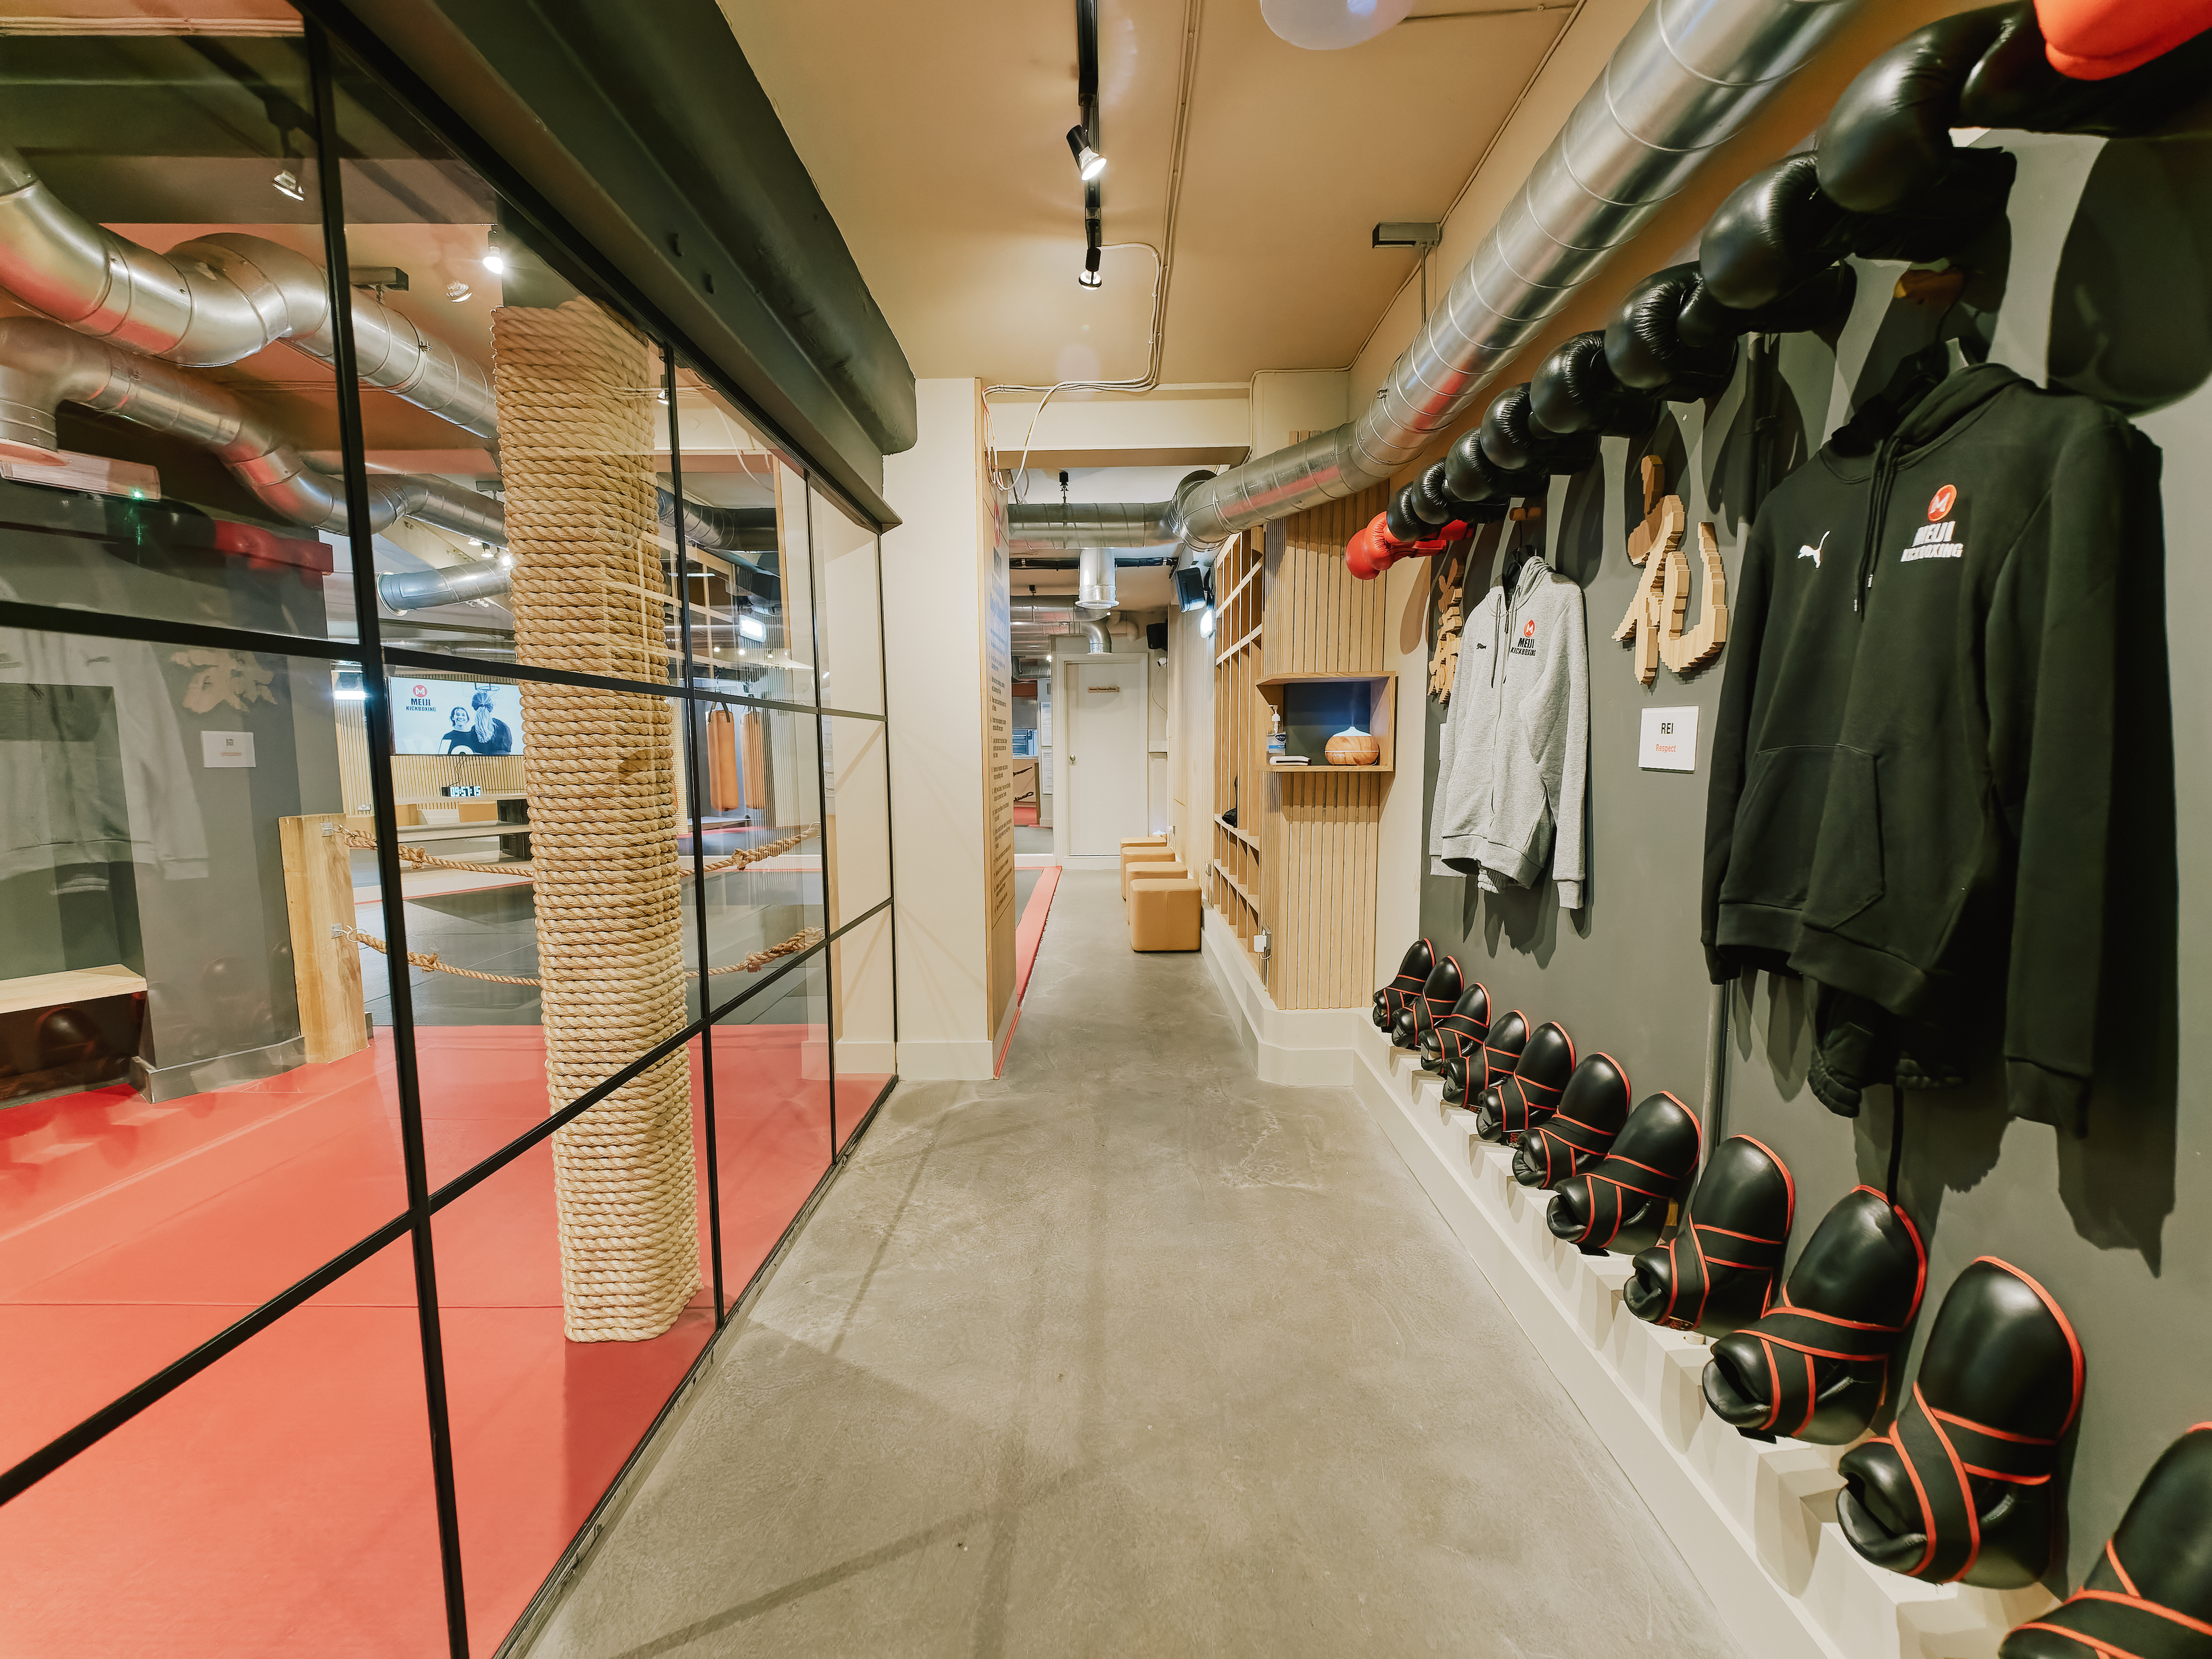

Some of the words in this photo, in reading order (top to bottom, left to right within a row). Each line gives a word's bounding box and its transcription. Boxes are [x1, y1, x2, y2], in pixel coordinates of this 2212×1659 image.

[1518, 637, 1534, 648] MEIJI
[1661, 723, 1674, 734] REI
[1656, 744, 1676, 753] Respect
[450, 786, 481, 797] 09:57:15
